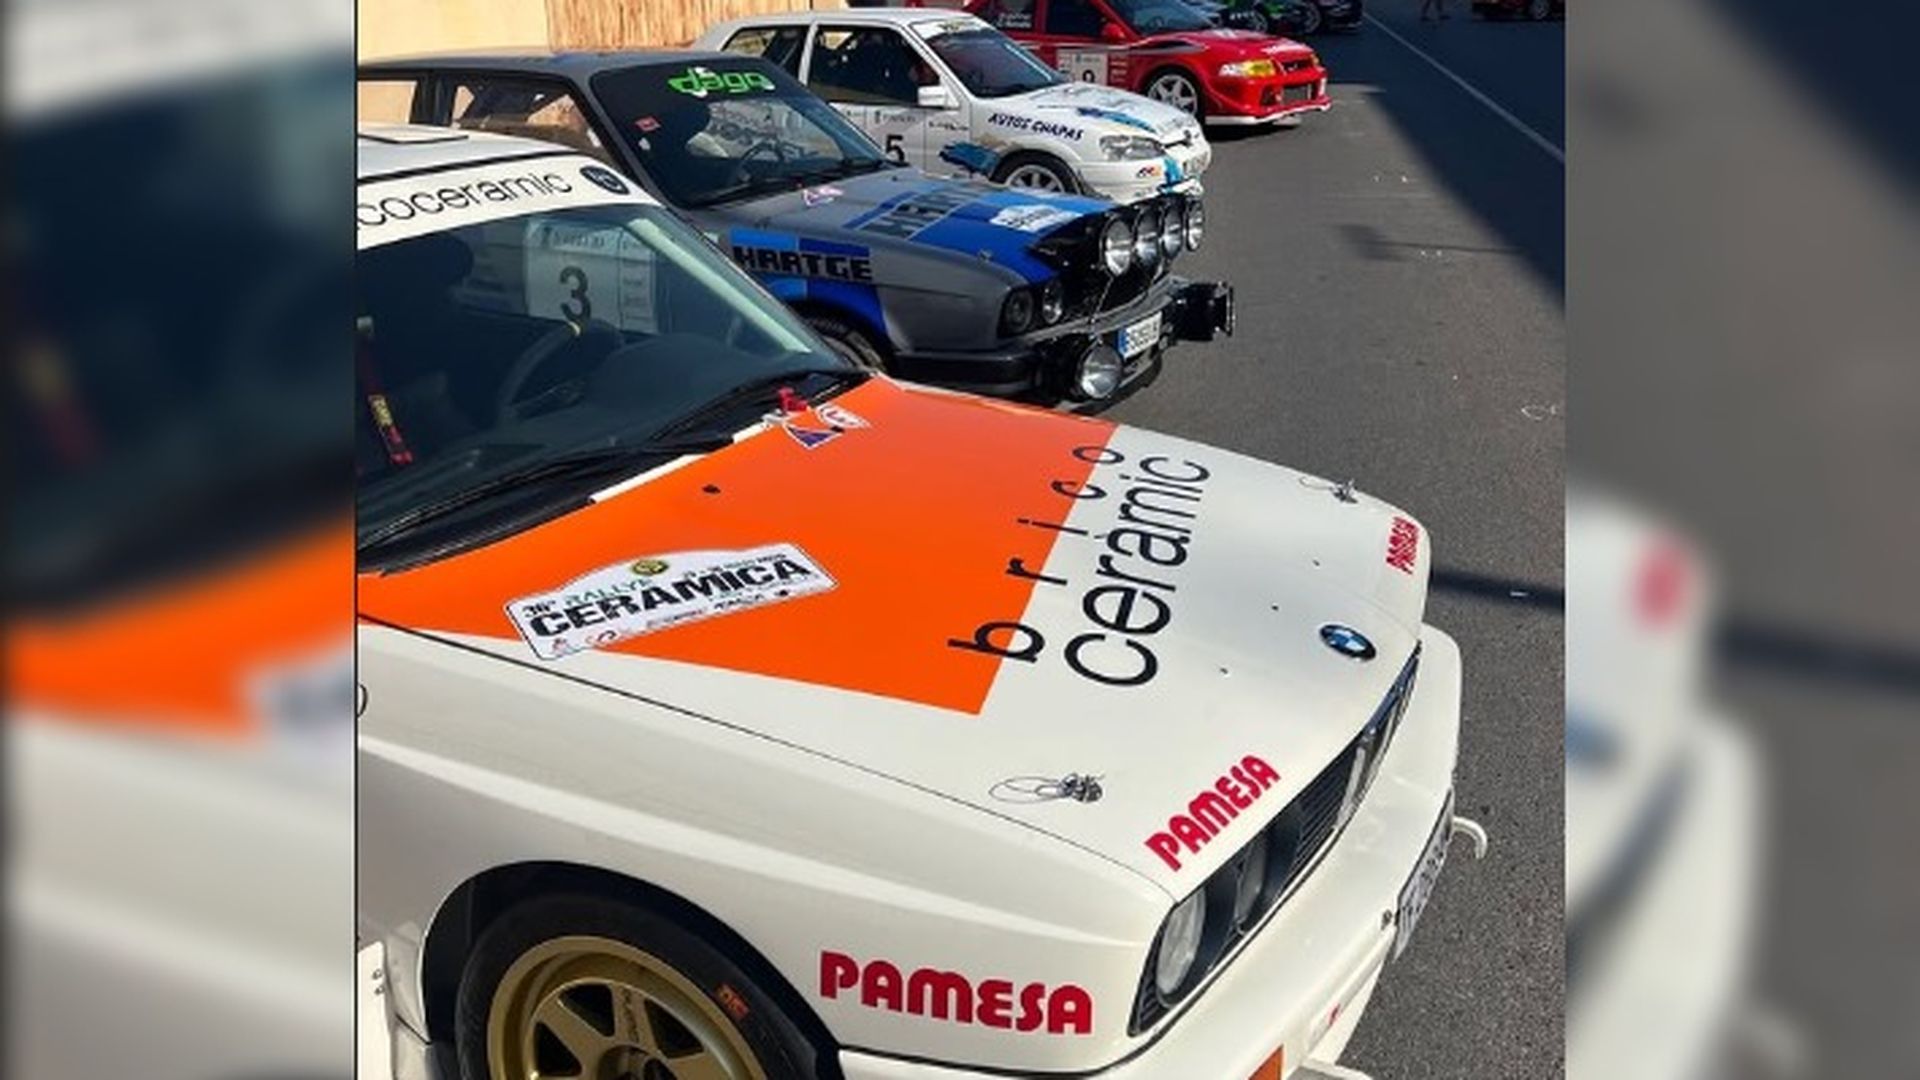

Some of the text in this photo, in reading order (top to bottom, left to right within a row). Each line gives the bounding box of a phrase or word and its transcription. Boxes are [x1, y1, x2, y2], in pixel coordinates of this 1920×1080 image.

[885, 134, 905, 162] 5
[357, 172, 573, 231] coceramic
[733, 246, 873, 281] HARTGE
[560, 266, 591, 324] 3
[530, 559, 812, 637] CERAMICA
[1145, 755, 1281, 872] PAMESA
[819, 950, 1092, 1035] PAMESA
